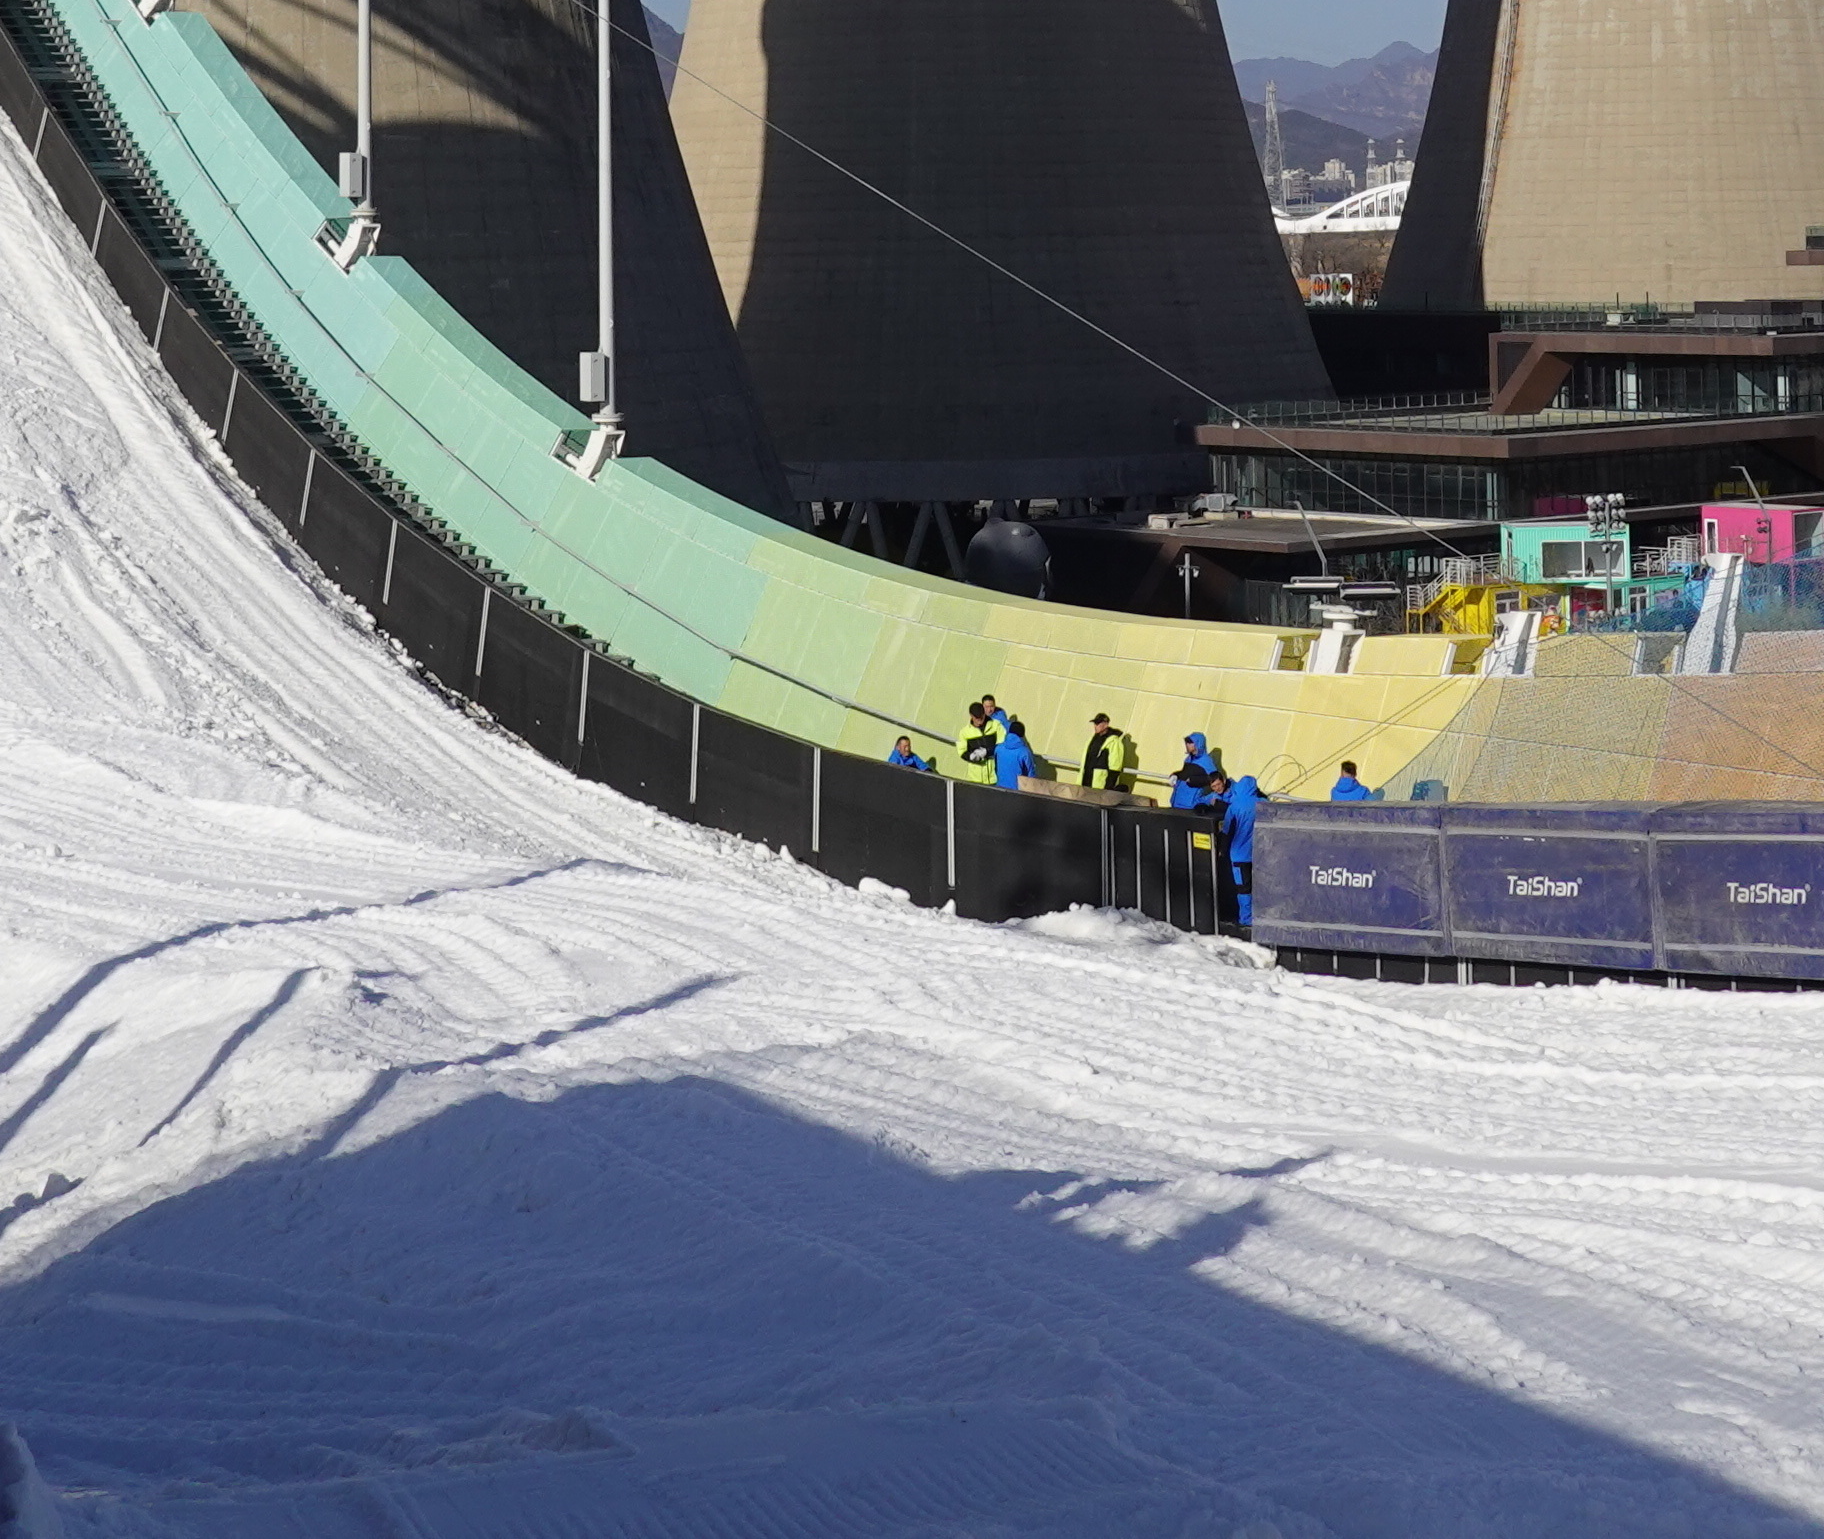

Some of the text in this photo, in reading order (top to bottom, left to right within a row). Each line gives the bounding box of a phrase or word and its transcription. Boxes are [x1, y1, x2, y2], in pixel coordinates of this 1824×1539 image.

[1309, 865, 1373, 888] TaiShan
[1506, 875, 1579, 898] TaiShan
[1726, 882, 1807, 904] TaiShan
